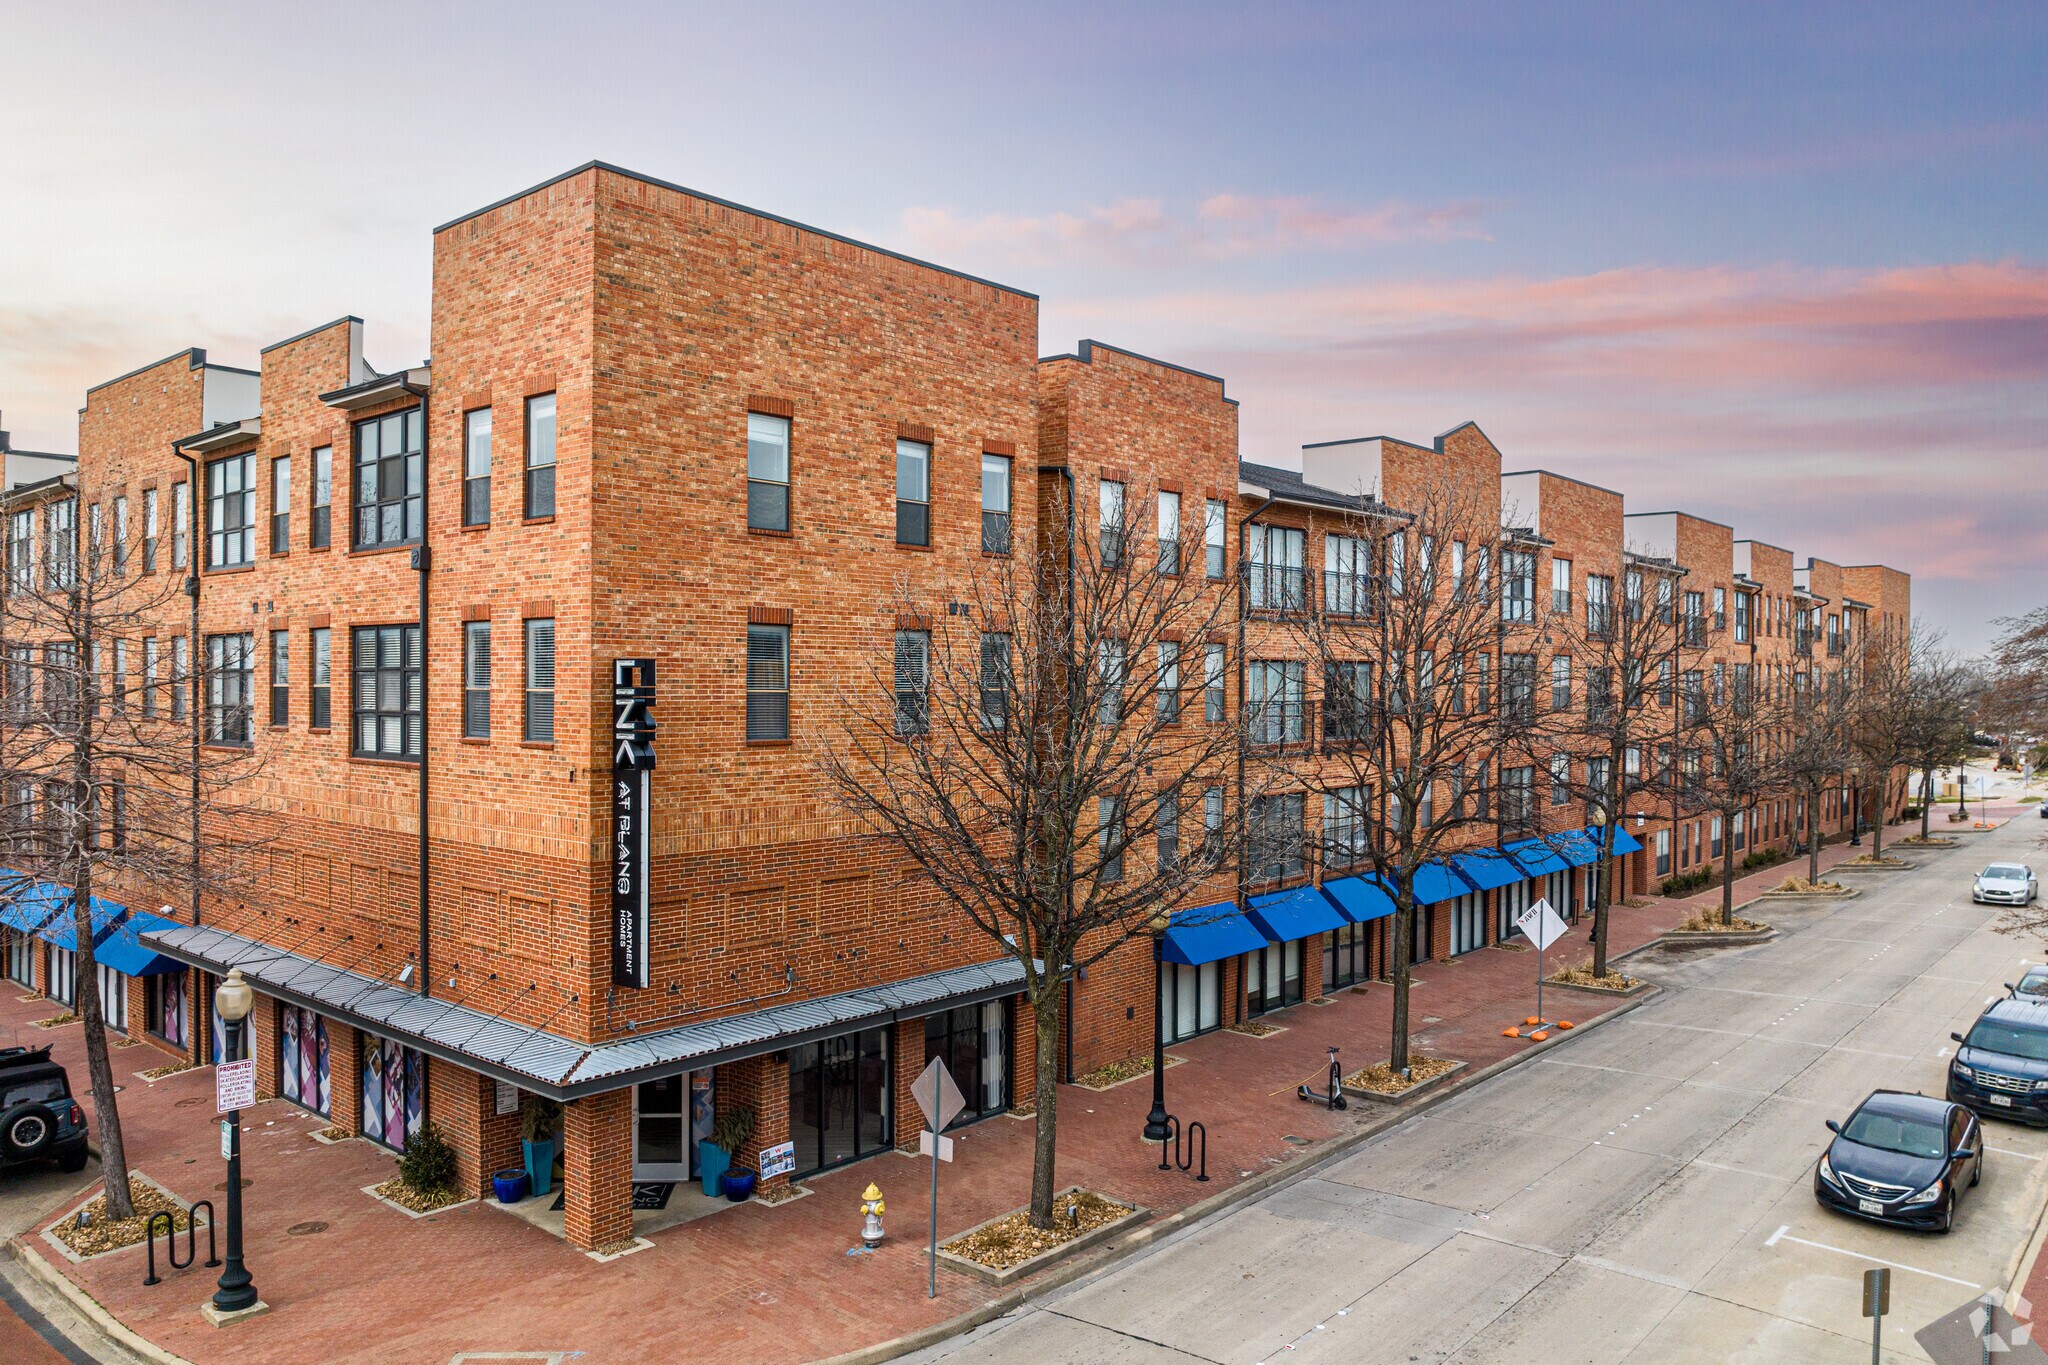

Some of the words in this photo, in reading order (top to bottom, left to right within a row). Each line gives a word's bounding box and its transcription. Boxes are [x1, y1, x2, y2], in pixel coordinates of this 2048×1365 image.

[618, 781, 630, 812] AT
[625, 910, 633, 974] APARTMENT
[220, 1062, 251, 1072] PROHIBITED
[220, 1069, 252, 1078] ROLLERBLADING
[220, 1074, 252, 1083] SKATEBOARDING
[220, 1079, 252, 1088] ROLLERSKATING
